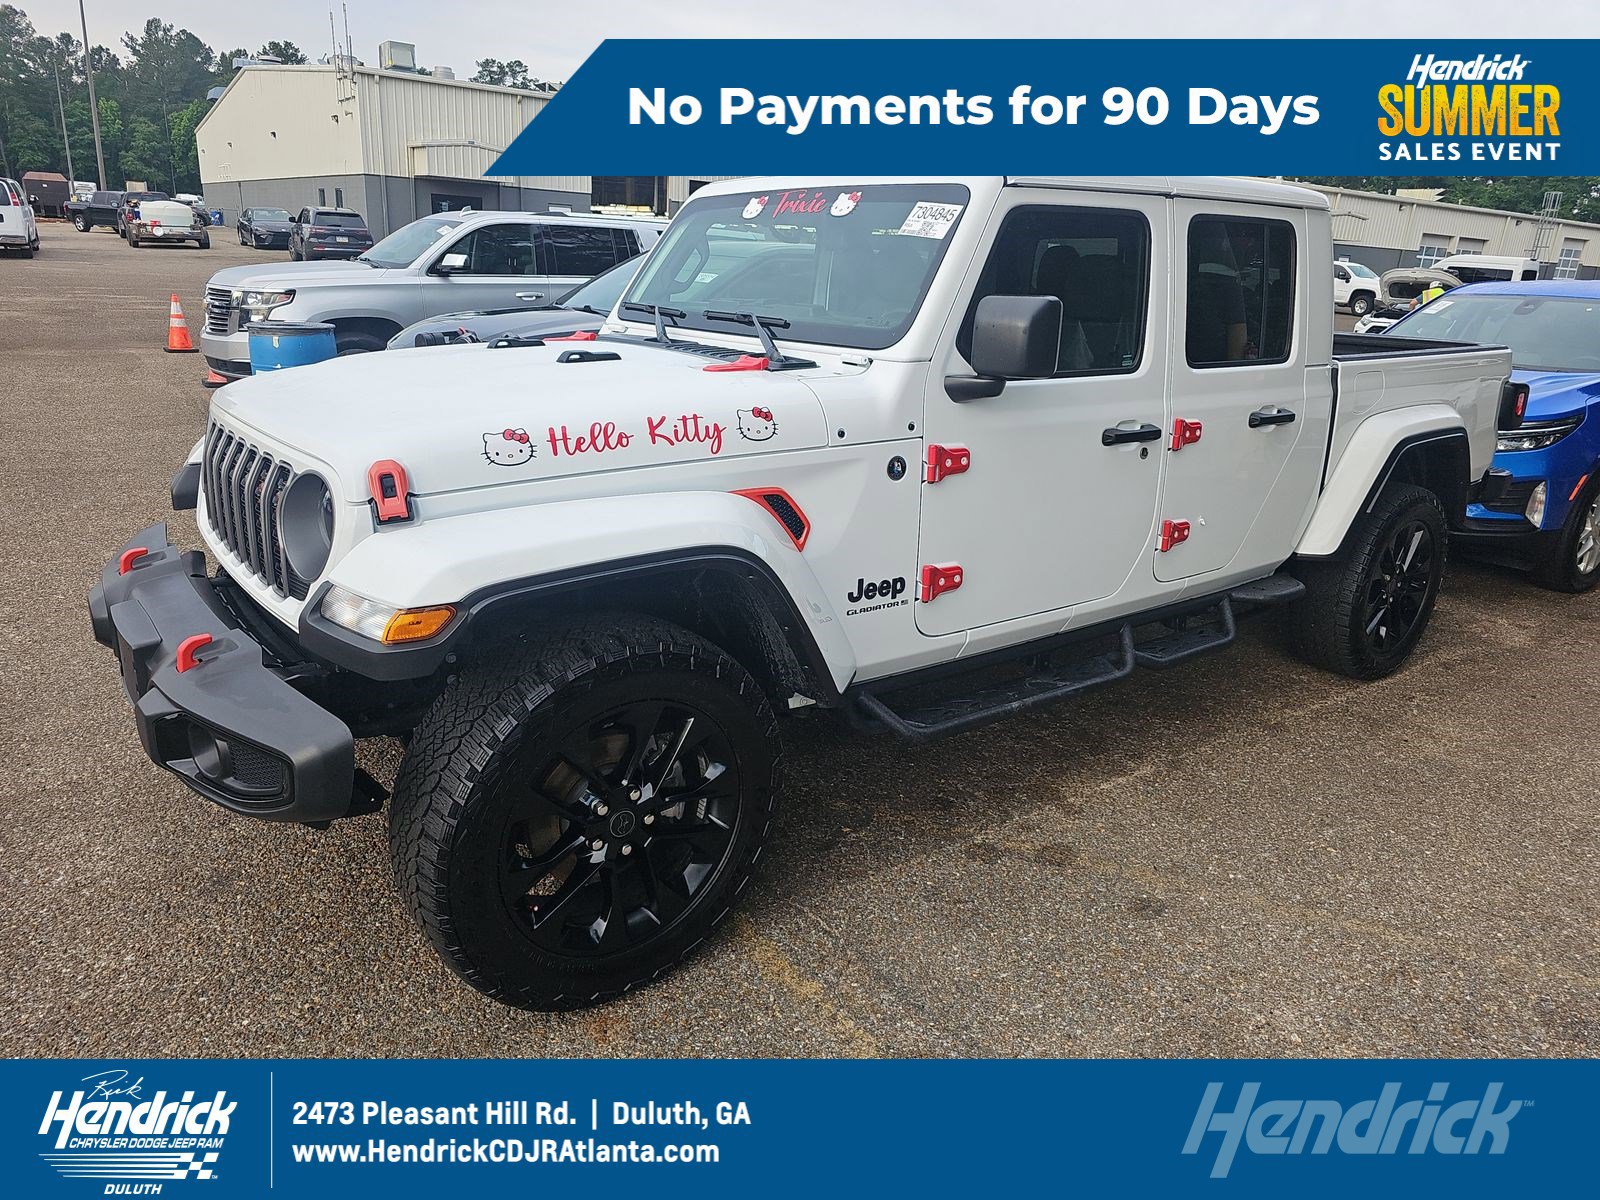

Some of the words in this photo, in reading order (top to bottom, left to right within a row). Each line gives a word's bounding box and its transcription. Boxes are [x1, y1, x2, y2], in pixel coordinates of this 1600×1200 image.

[772, 189, 827, 218] Trixie
[912, 205, 958, 222] 7304845
[546, 422, 634, 457] Hello
[647, 414, 727, 455] Kitty
[847, 576, 906, 603] Jeep
[846, 601, 900, 616] GLADIATOR
